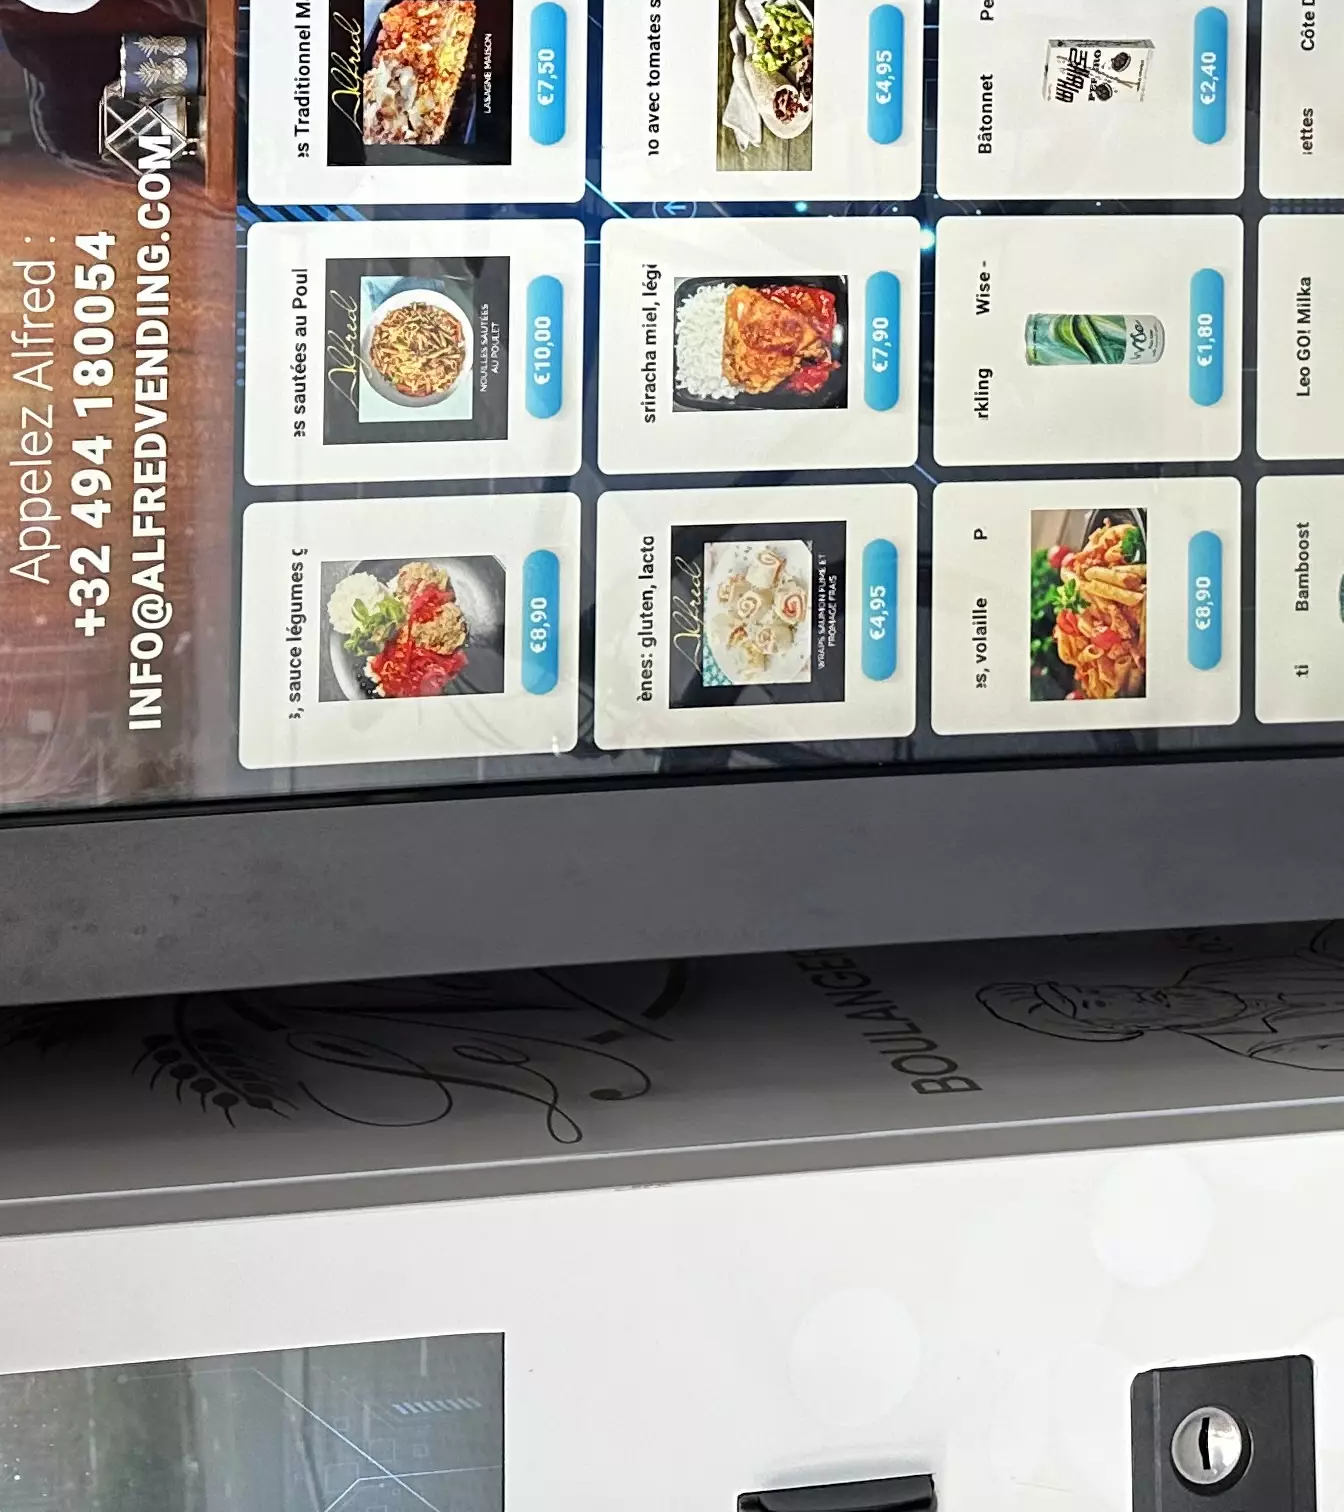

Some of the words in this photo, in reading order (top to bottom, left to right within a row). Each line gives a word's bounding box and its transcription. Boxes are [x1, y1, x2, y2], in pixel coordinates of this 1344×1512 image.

[646, 14, 662, 87] tomates
[1300, 11, 1316, 51] Côte
[294, 24, 311, 137] Traditionnel
[537, 49, 558, 106] €7,50
[876, 50, 895, 104] €4,95
[1199, 51, 1219, 105] €2,40
[649, 92, 662, 133] avec
[976, 74, 994, 154] Bâtonnet
[1299, 108, 1315, 155] ettes
[291, 269, 309, 309] Poul
[975, 272, 991, 315] Wise
[1295, 276, 1312, 324] Milka
[11, 259, 56, 392] Alfred
[73, 231, 116, 417] 180054
[295, 315, 308, 337] au
[534, 315, 554, 385] €10,00
[642, 301, 660, 346] miel,
[871, 317, 890, 373] €7,90
[1196, 313, 1215, 367] €1,80
[1295, 329, 1312, 361] GO!
[290, 342, 308, 415] sautées
[641, 350, 657, 423] sriracha
[974, 367, 994, 420] rkling
[1295, 366, 1312, 397] Leo
[128, 133, 175, 731] INFO@ALFREDVENDING.COM
[9, 404, 59, 585] Appelez
[71, 435, 113, 529] 494
[974, 527, 988, 540] P
[70, 545, 112, 637] +32
[1294, 522, 1311, 612] Bamboost
[285, 561, 308, 641] légumes
[530, 597, 551, 654] €8,90
[637, 584, 657, 648] gluten,
[869, 585, 889, 640] €4,95
[1194, 576, 1214, 630] €8,90
[972, 597, 989, 663] volaille
[288, 646, 303, 702] sauce
